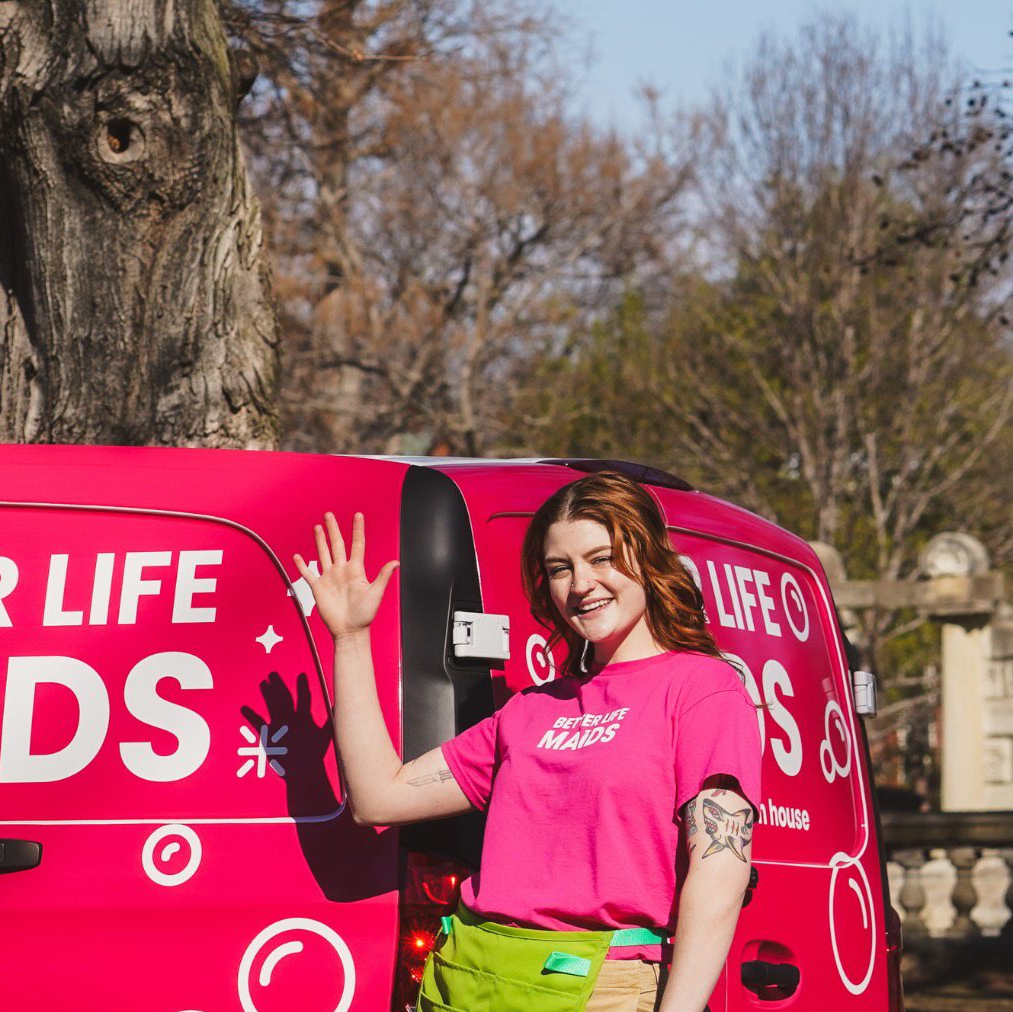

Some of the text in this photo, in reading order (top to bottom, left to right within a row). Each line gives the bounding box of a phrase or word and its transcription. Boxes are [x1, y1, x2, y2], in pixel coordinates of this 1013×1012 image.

[42, 550, 224, 627] LIFE
[706, 559, 782, 637] LIFE
[553, 707, 631, 729] BETER LIFE
[537, 723, 620, 750] MAIDS
[768, 798, 810, 831] house
